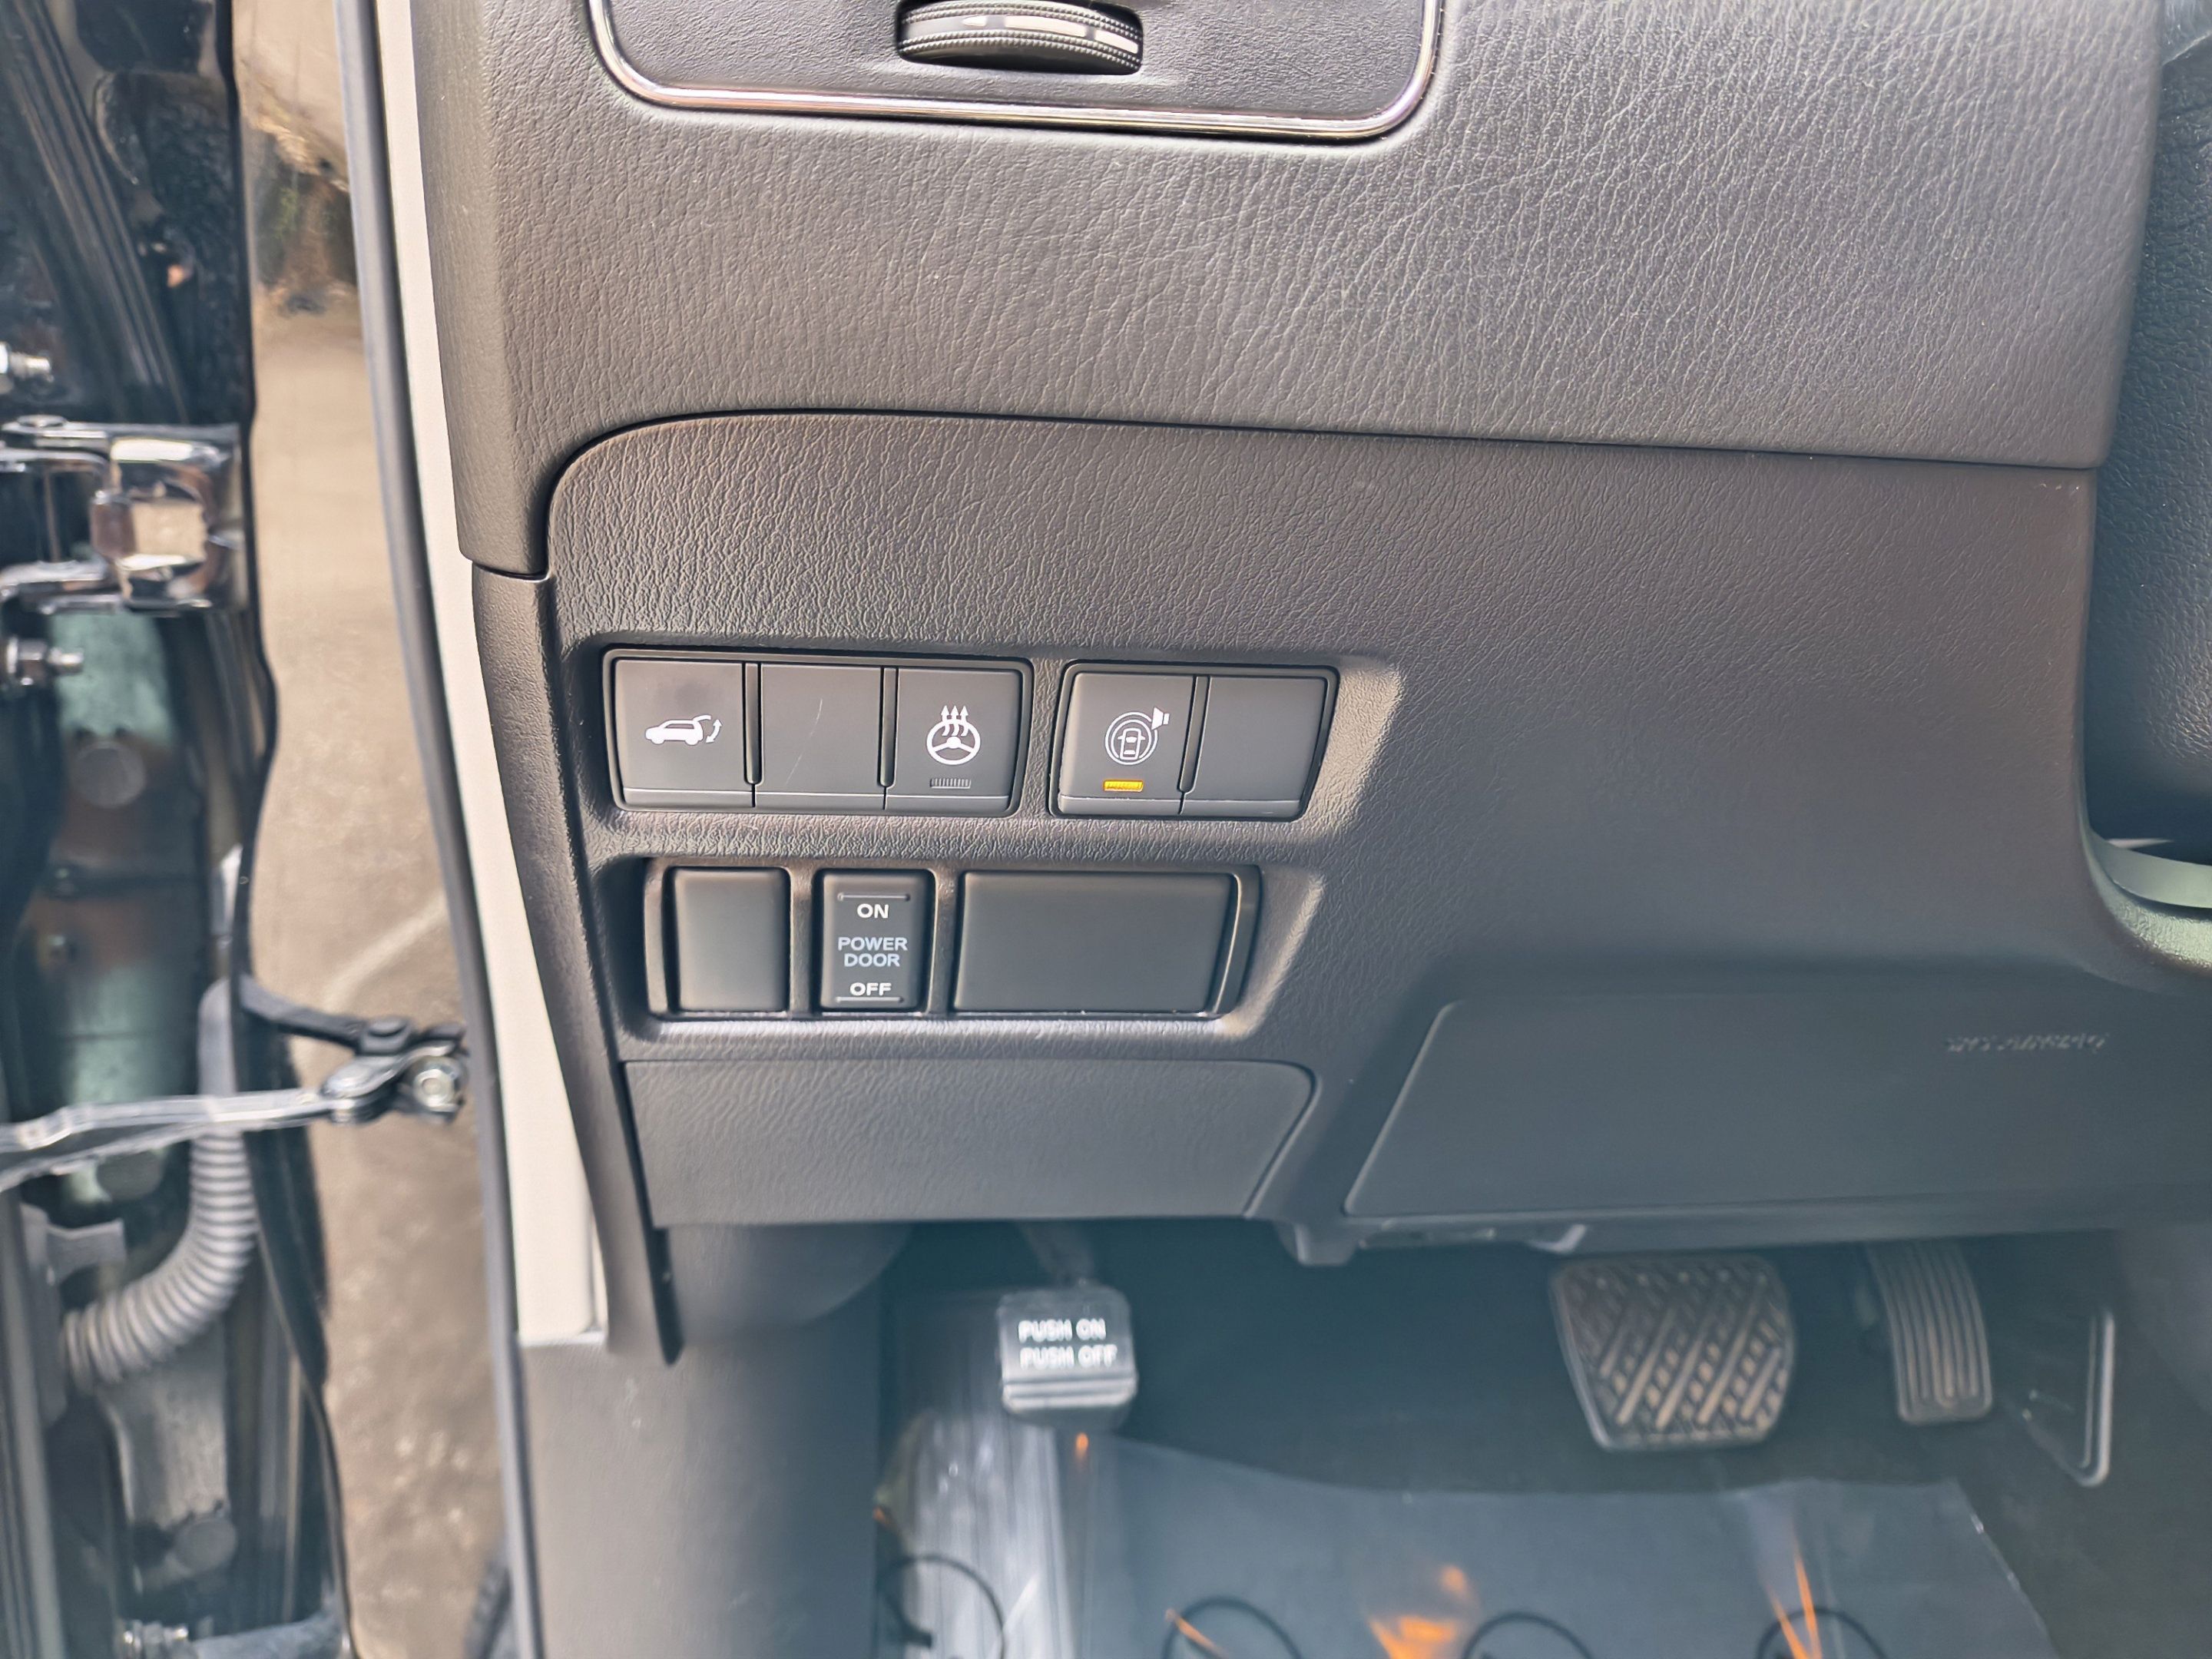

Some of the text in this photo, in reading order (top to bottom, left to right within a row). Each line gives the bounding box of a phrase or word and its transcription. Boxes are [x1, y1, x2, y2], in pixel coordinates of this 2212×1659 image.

[856, 903, 889, 919] ON
[837, 936, 908, 951] POWER
[845, 952, 900, 967] DOOR
[849, 982, 892, 996] OFF
[1018, 1318, 1106, 1343] PUSH ON
[1020, 1344, 1118, 1369] PUSH OFF
